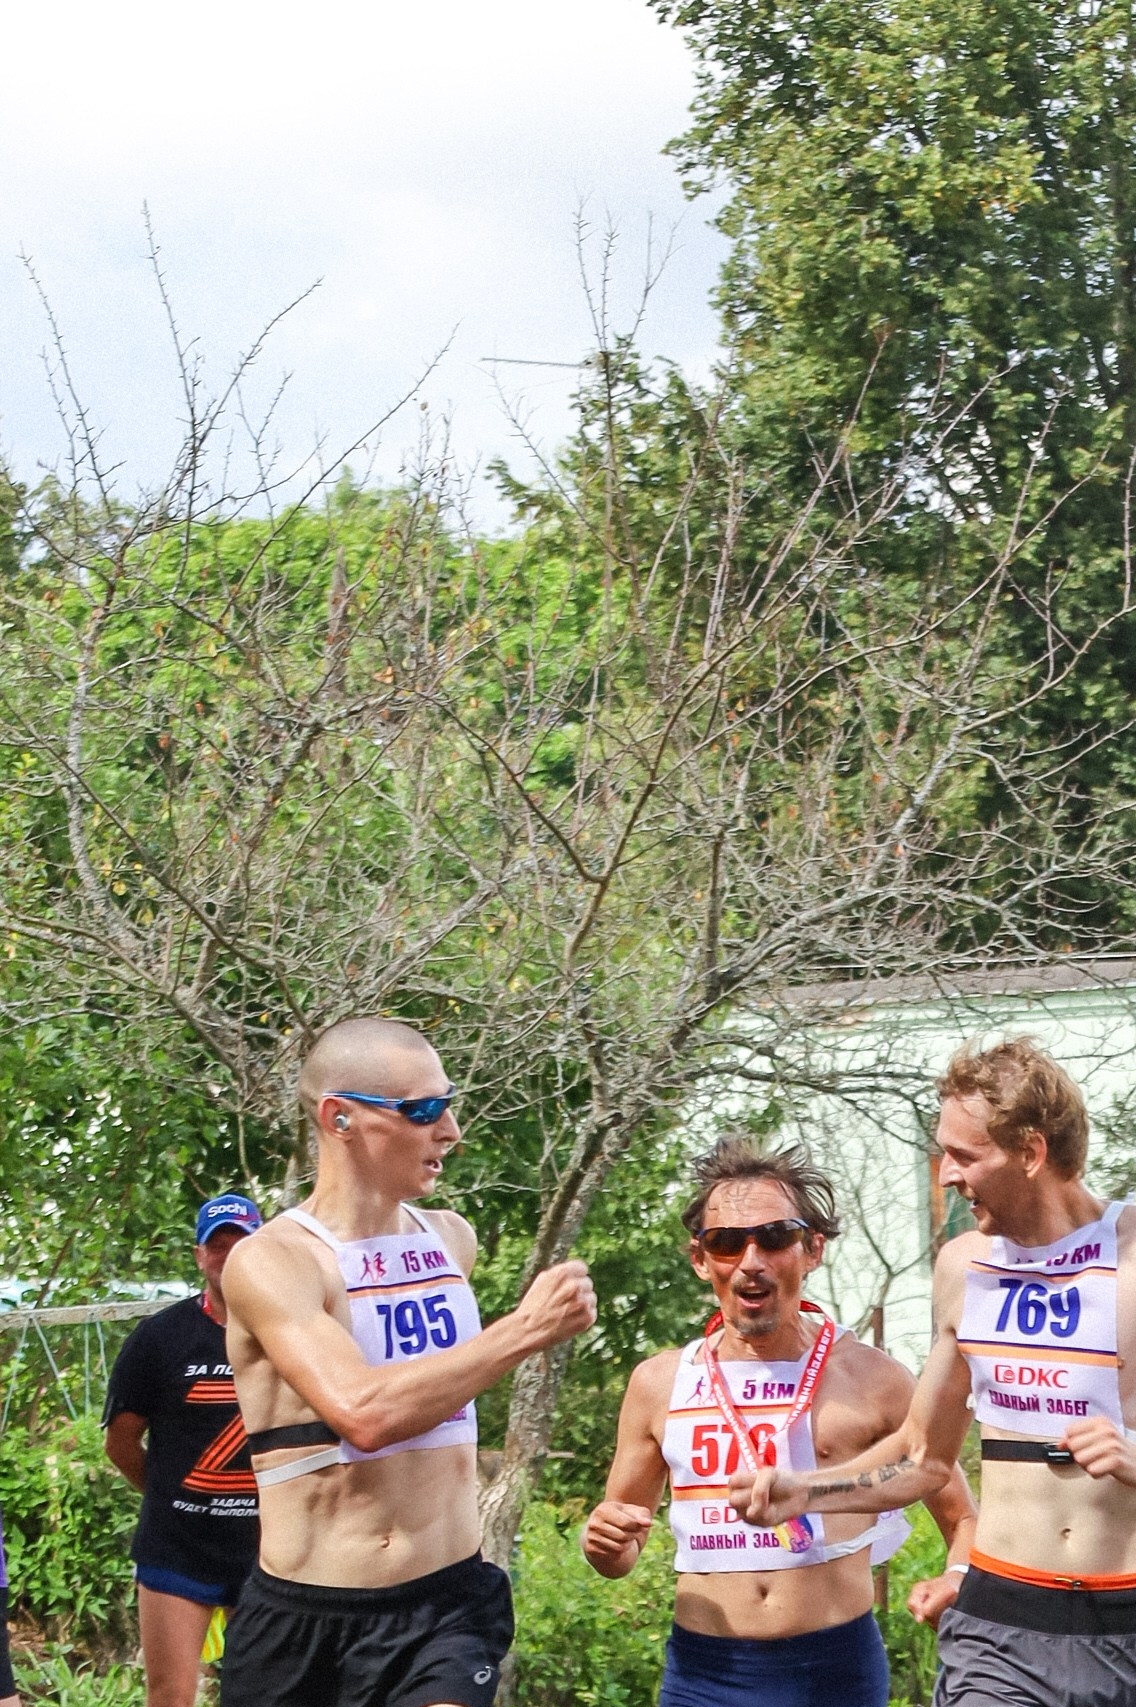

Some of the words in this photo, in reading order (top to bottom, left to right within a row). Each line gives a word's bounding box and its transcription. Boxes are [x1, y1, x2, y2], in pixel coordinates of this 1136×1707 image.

[401, 1250, 421, 1274] 15
[995, 1278, 1081, 1338] 769
[376, 1294, 458, 1360] 795
[184, 1364, 208, 1377] ЗА
[1018, 1366, 1069, 1388] DKC
[742, 1379, 757, 1400] 5
[1046, 1398, 1090, 1417] ЗАБЕГ
[210, 1498, 256, 1508] ЗАДАЧА
[690, 1531, 747, 1550] СЛАВНЫЙ
[753, 1533, 781, 1549] ЗАБ
